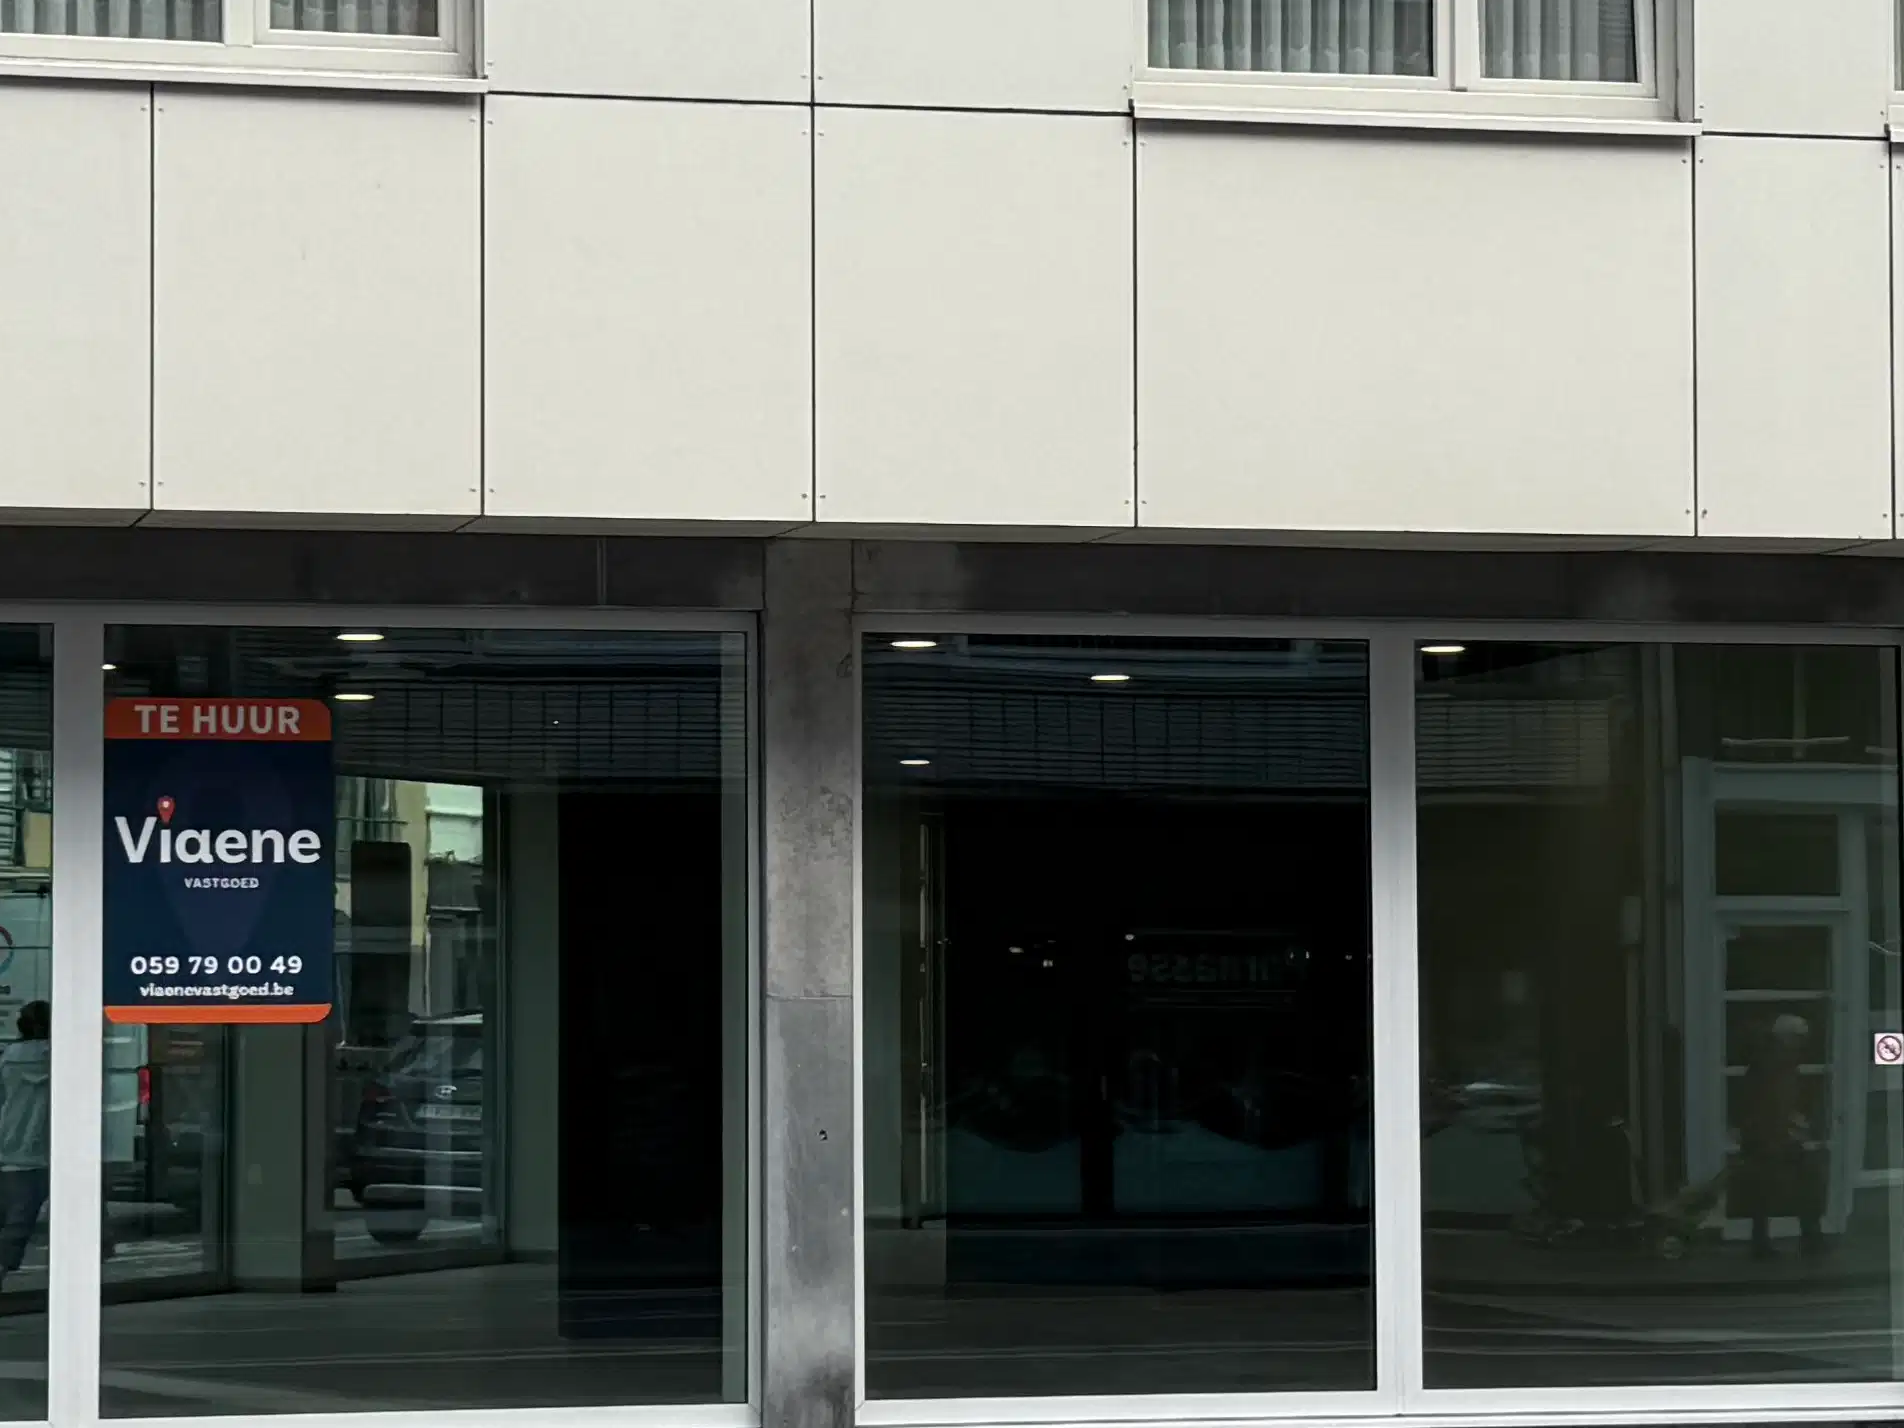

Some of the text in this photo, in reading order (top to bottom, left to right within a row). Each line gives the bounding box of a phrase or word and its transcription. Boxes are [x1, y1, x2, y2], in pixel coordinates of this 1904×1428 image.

[134, 704, 301, 735] TE HUUR
[114, 796, 322, 864] Viaene
[184, 877, 260, 889] VASTGOED
[130, 956, 303, 975] 059 79 00 49
[140, 982, 295, 1000] viaenevastgoed.be
